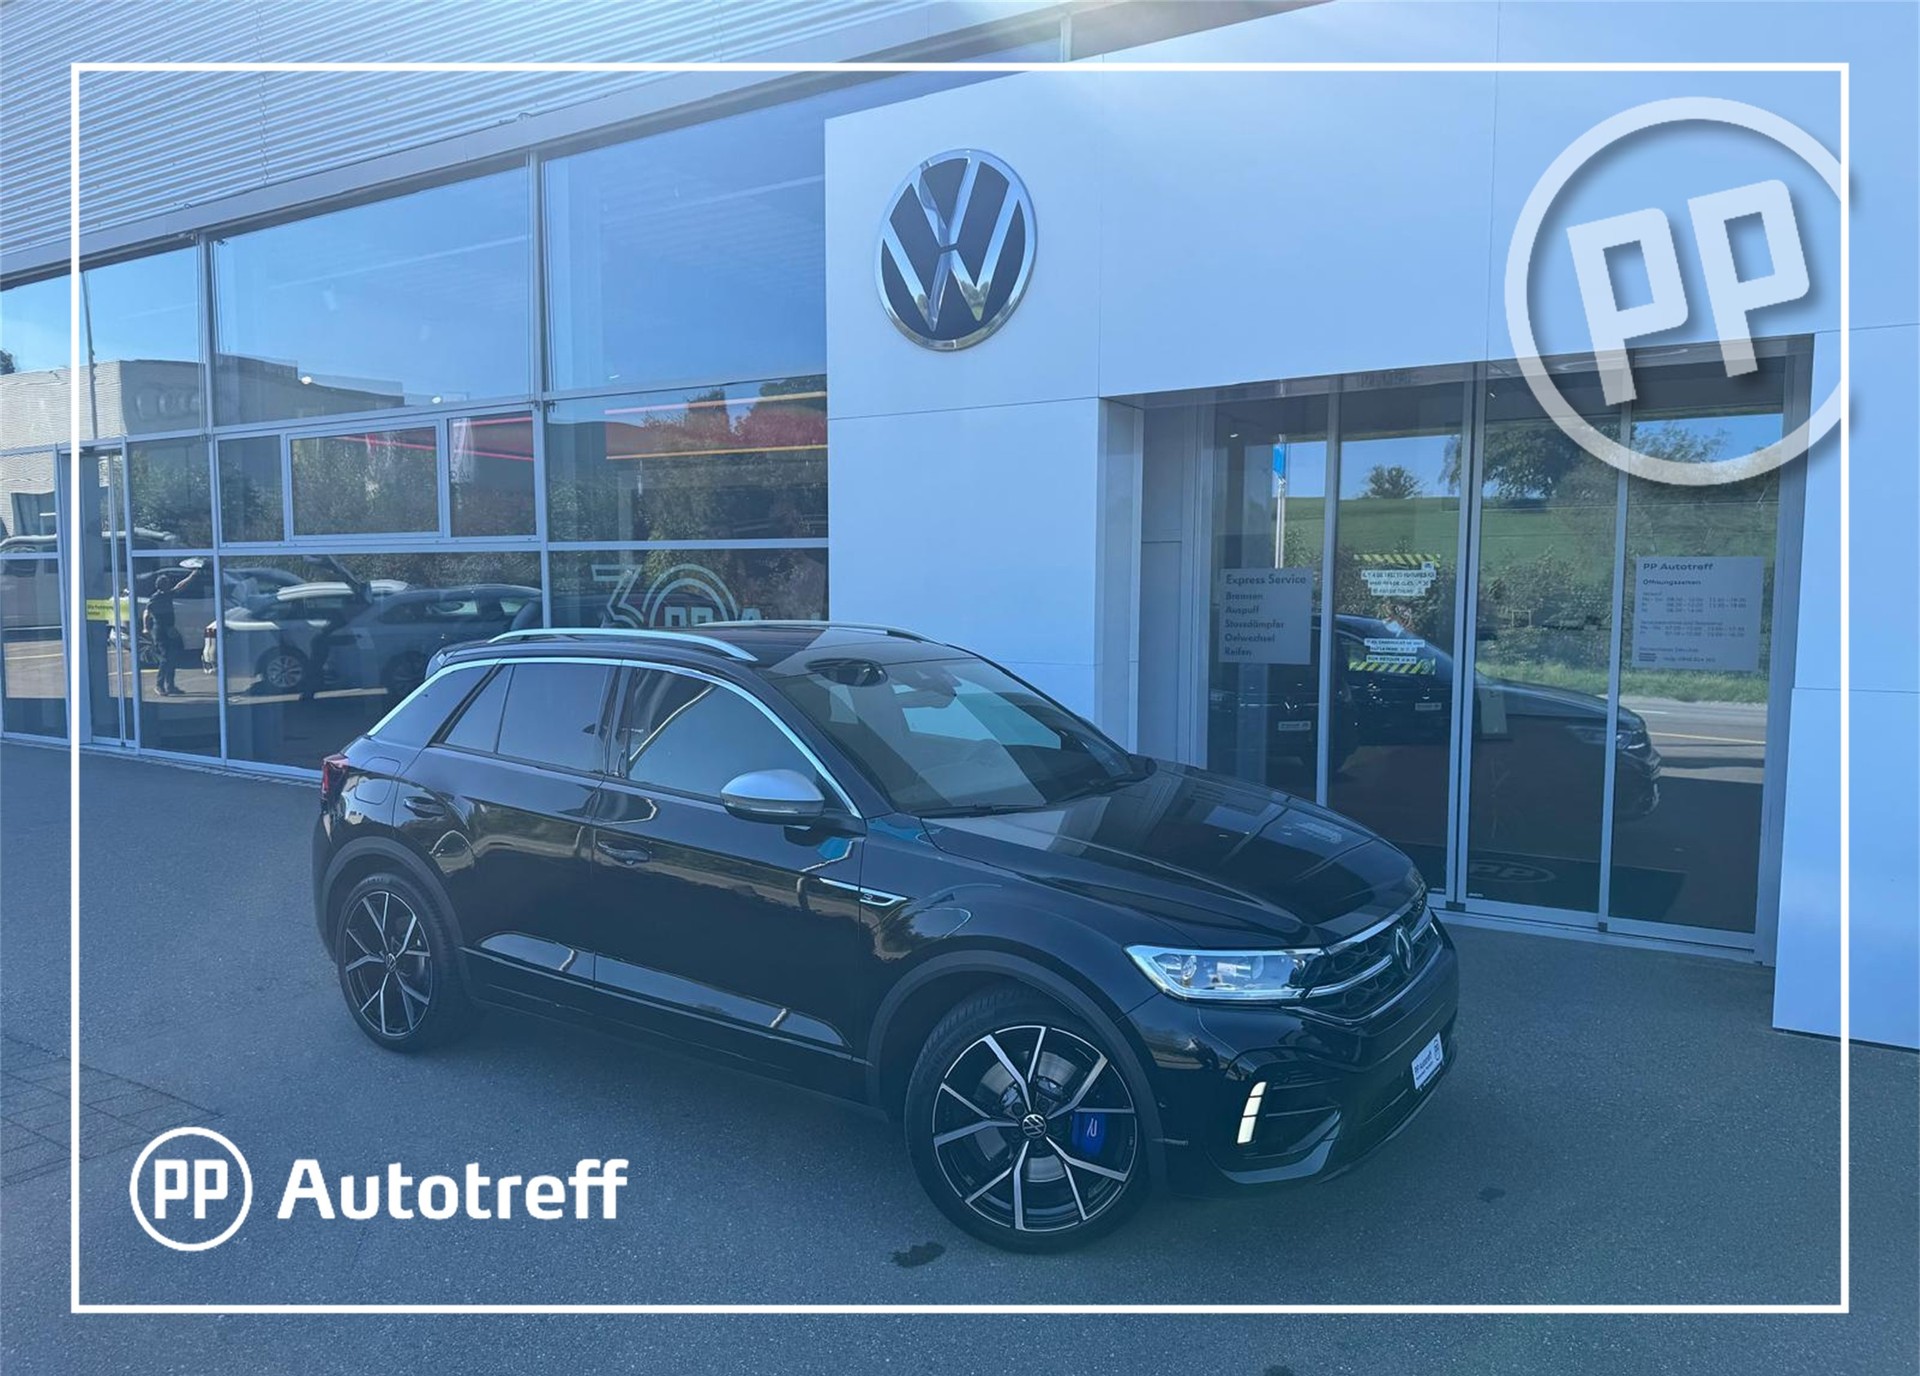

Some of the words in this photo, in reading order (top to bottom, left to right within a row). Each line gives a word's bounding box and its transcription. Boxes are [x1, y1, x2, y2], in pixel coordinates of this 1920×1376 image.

[1225, 573, 1265, 587] Express
[1268, 573, 1307, 585] Service
[1225, 605, 1260, 615] Auspuff
[1224, 646, 1252, 656] Reifen
